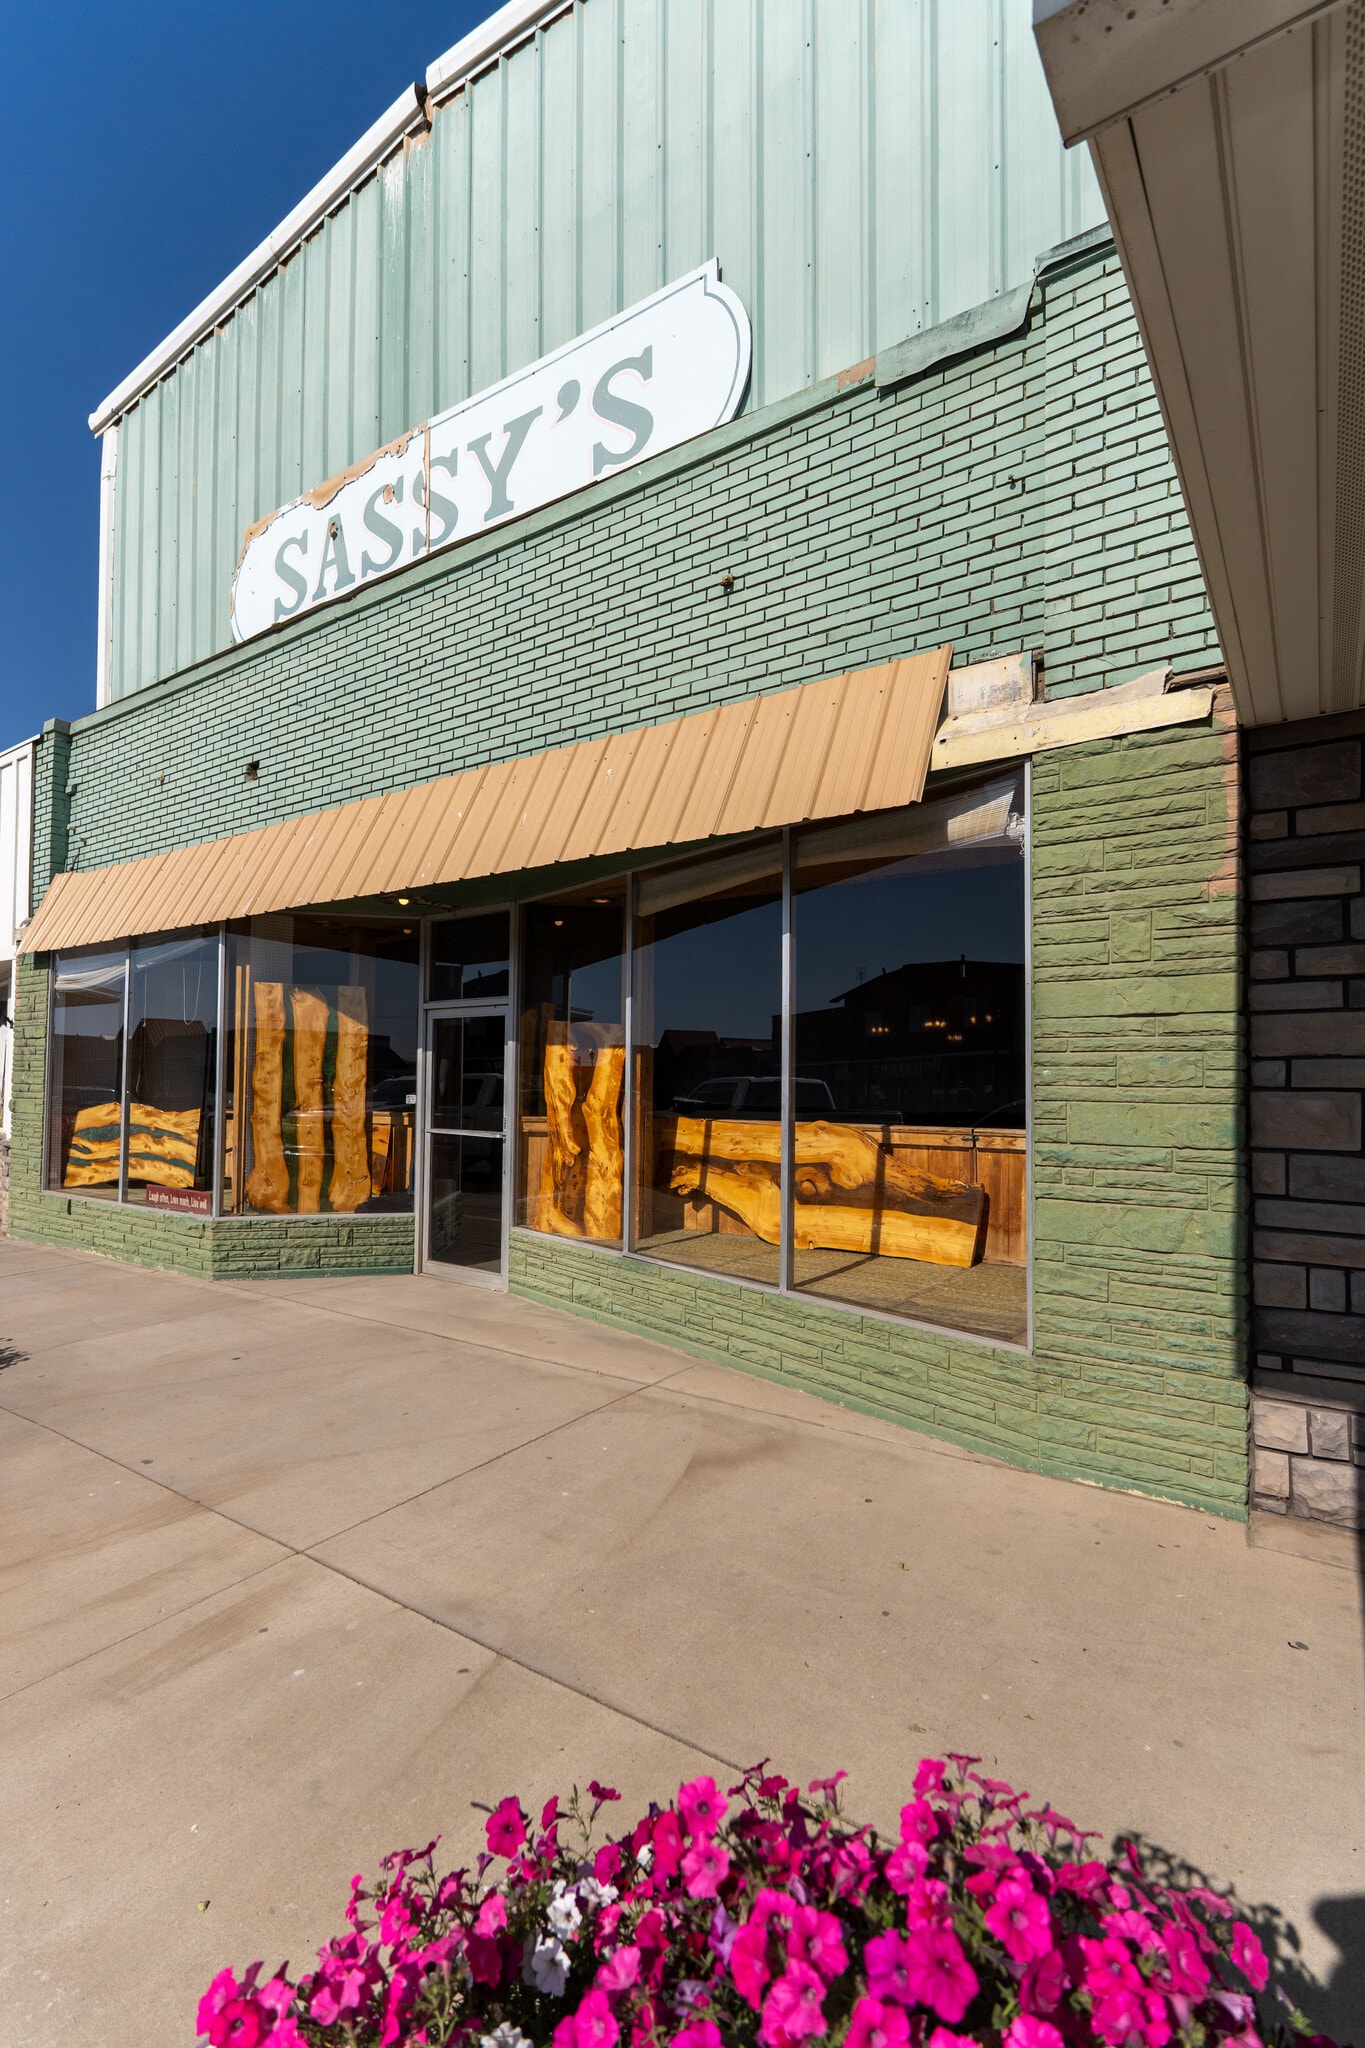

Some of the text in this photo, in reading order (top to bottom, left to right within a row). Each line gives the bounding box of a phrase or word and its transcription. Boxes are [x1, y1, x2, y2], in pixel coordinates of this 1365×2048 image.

[273, 344, 655, 622] SASSY'S
[170, 1193, 179, 1205] Love
[190, 1196, 199, 1208] Live
